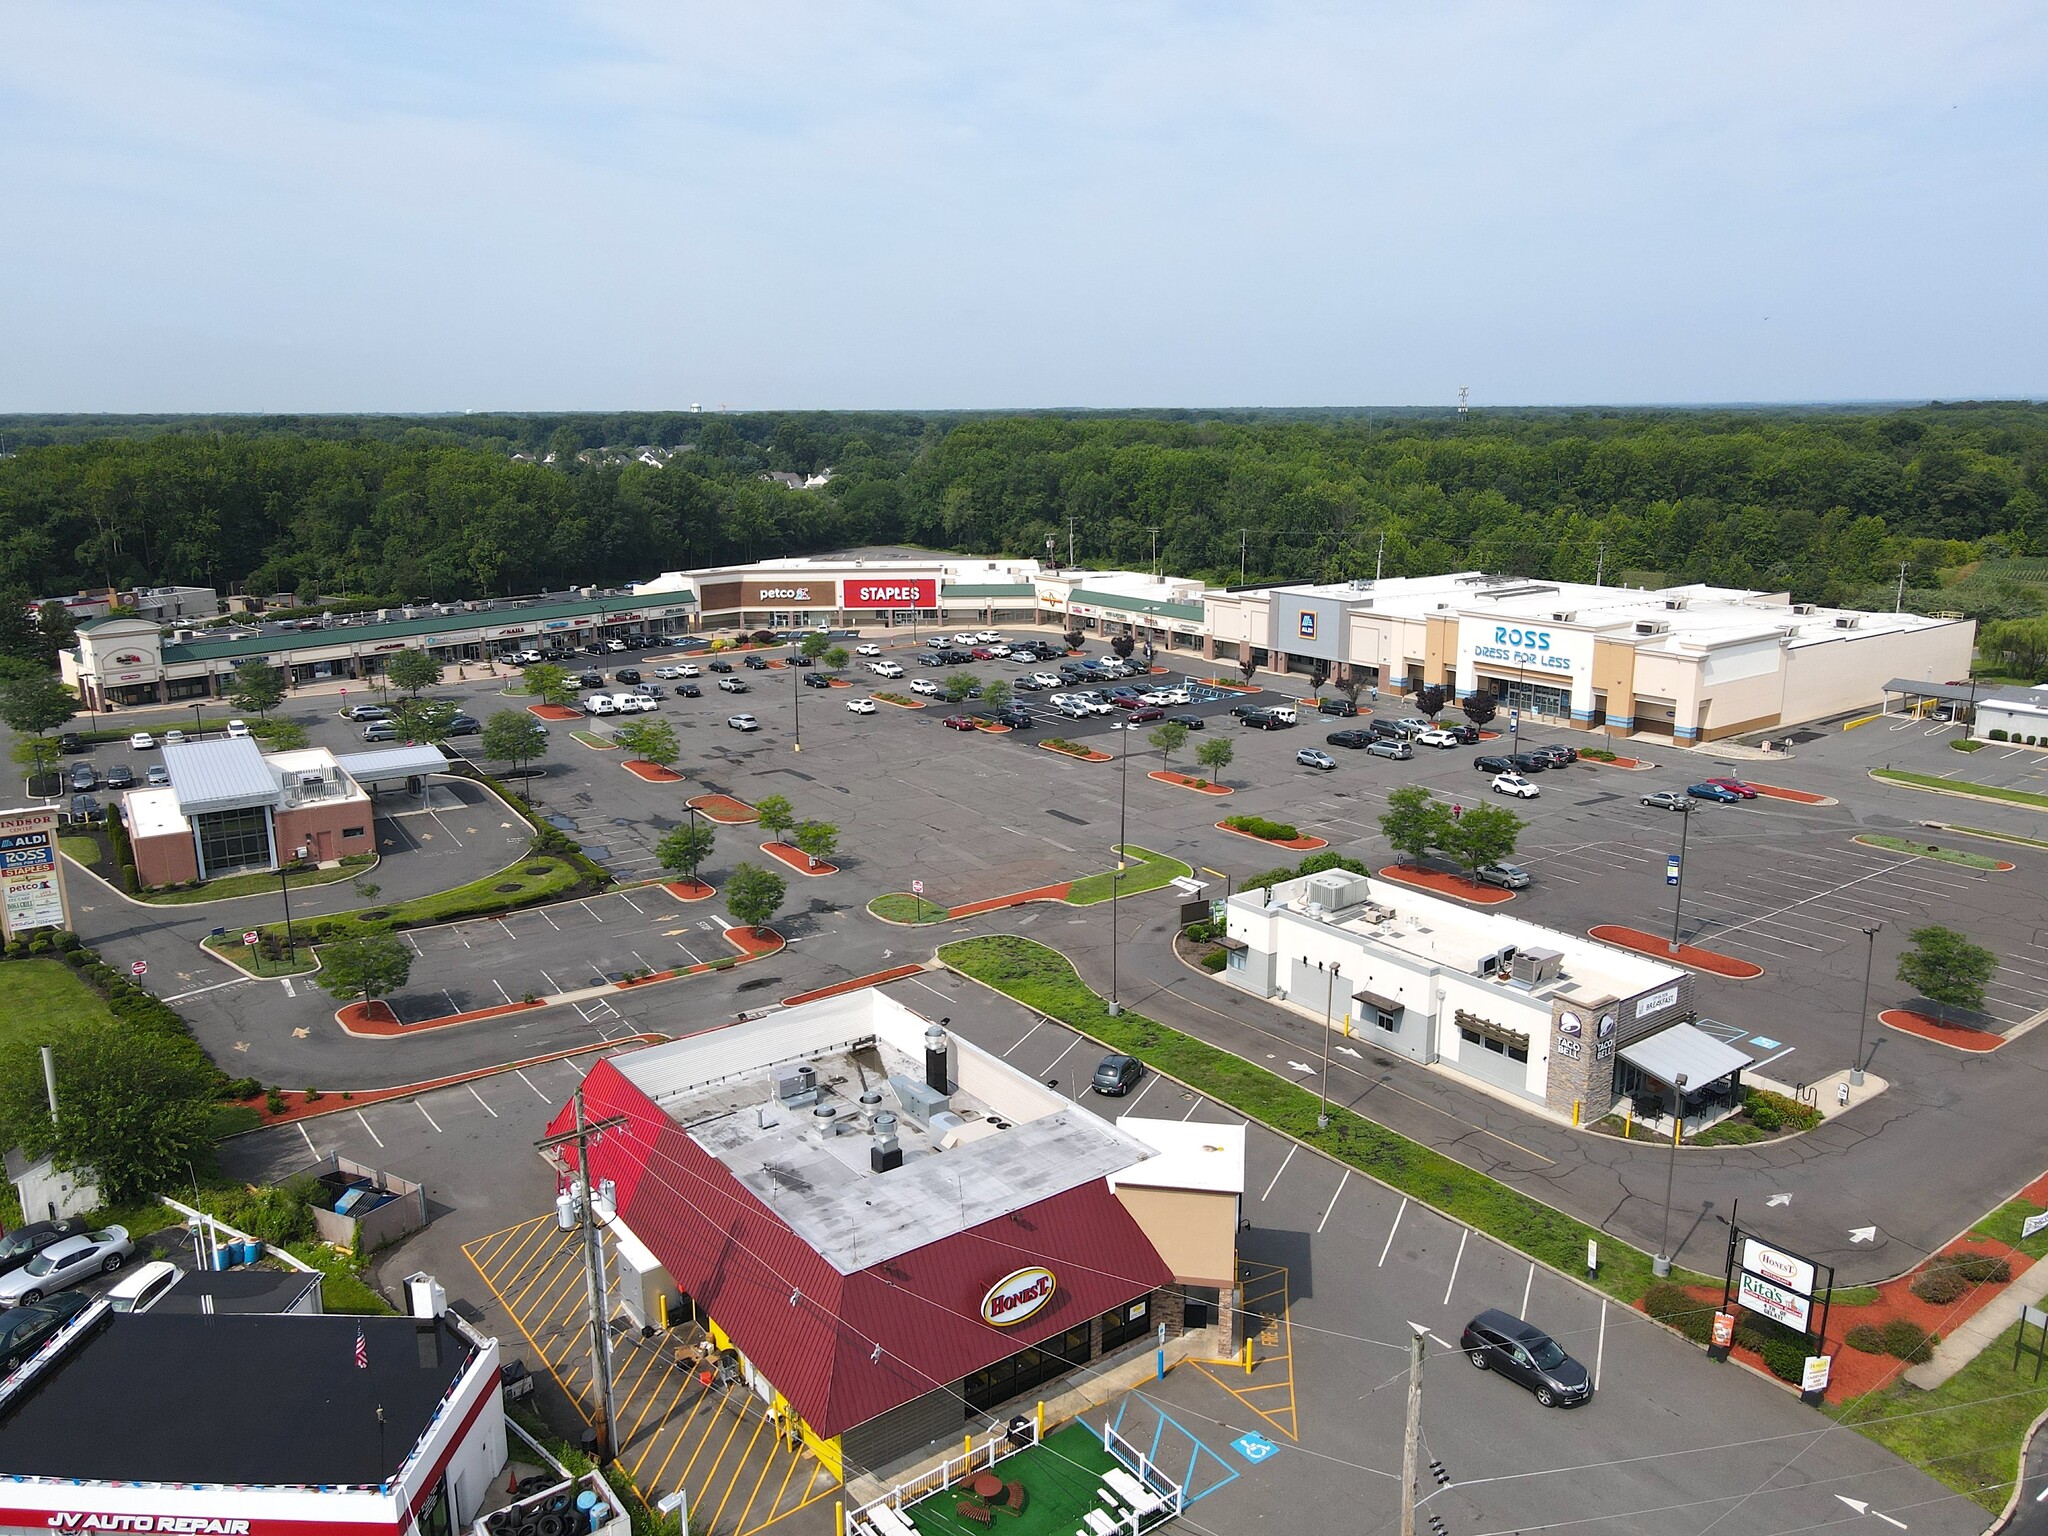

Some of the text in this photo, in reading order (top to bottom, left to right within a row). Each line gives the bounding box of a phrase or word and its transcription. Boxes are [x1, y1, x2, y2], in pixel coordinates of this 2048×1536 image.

[760, 588, 795, 601] petco
[860, 587, 921, 601] STAPLES
[506, 626, 525, 634] NAILS
[1301, 626, 1314, 634] ALDI
[1495, 626, 1551, 650] ROSS
[1475, 645, 1571, 669] DRESS FOR LESS
[0, 816, 52, 828] INDSOR
[16, 835, 47, 846] ALDI
[6, 849, 46, 863] ROSS
[6, 864, 50, 876] STAPLES
[9, 883, 38, 893] petco
[1645, 995, 1674, 1010] BREAKFAST
[1557, 1037, 1581, 1051] TACO
[1596, 1040, 1613, 1051] TACO
[1557, 1045, 1581, 1060] BELL
[1596, 1049, 1612, 1060] BELL
[1762, 1254, 1794, 1274] HONEST
[1744, 1275, 1783, 1303] Rita's
[1763, 1308, 1784, 1320] GELATI
[48, 1512, 250, 1535] JV AUTO REPAIR
